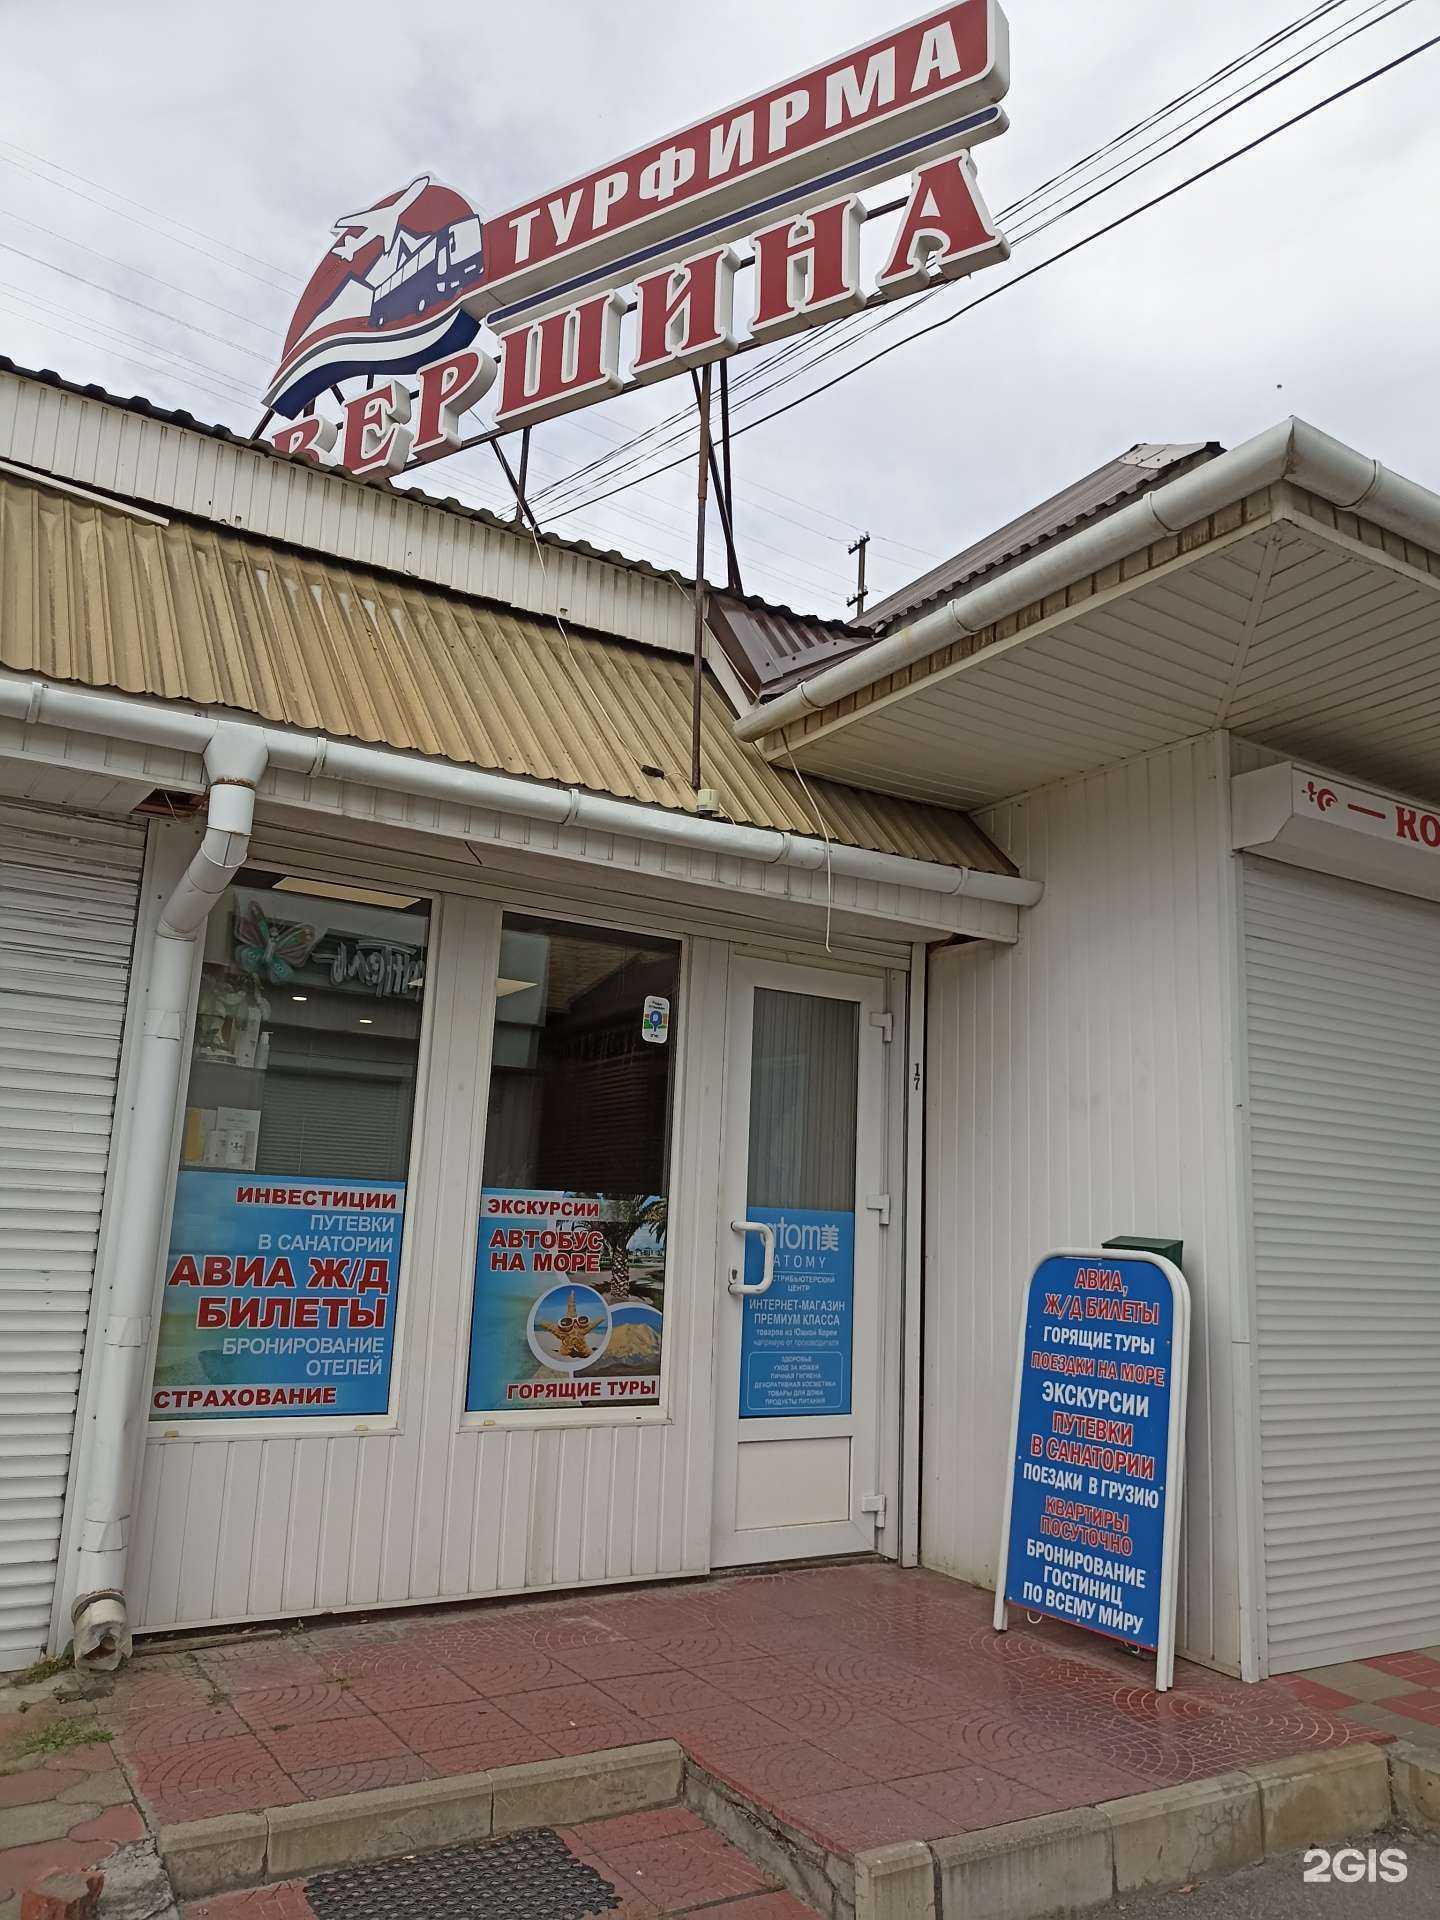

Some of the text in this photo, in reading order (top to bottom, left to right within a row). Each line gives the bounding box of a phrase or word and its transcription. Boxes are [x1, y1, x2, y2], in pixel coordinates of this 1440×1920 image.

[509, 22, 962, 264] ТУРФИРМА
[272, 150, 1003, 476] ВЕРШИНА
[236, 1187, 396, 1210] ИНВЕСТИЦИИ
[488, 1199, 600, 1217] ЭКСКУРСИИ
[310, 1215, 394, 1232] ПУТЕВКИ
[258, 1234, 392, 1252] В САНАТОРИИ
[489, 1229, 603, 1250] АВТОБУС
[168, 1255, 390, 1295] АВИА Ж/Д
[491, 1252, 601, 1272] НА МОРЕ
[774, 1254, 826, 1268] ATOMY
[1074, 1268, 1128, 1297] АВИА,
[196, 1296, 387, 1329] БИЛЕТЫ
[749, 1299, 845, 1311] ИНТЕРНЕТ-МАГАЗИН
[754, 1313, 840, 1326] ПРЕМИУМ КЛАССА
[1043, 1293, 1160, 1325] Ж/Д БИЛЕТЫ
[223, 1337, 384, 1355] БРОНИРОВАНИЕ
[1043, 1326, 1155, 1355] ГОРЯЩИЕ ТУРЫ
[306, 1355, 382, 1376] ОТЕЛЕЙ
[1031, 1351, 1165, 1387] ПОЕЗДКИ НА МОРЕ
[153, 1387, 337, 1409] СТРАХОВАНИЕ
[507, 1380, 656, 1400] ГОРЯЩИЕ ТУРЫ
[1042, 1380, 1149, 1418] ЭКСКУРСИИ
[1052, 1410, 1134, 1447] ПУТЕВКИ
[1031, 1434, 1155, 1480] В САНАТОРИИ
[1023, 1463, 1158, 1509] ПОЕЗДКИ В ГРУЗИЮ
[1044, 1495, 1129, 1533] КВАРТИРЫ
[1040, 1517, 1133, 1556] ПОСУТОЧНО
[1026, 1538, 1146, 1588] БРОНИРОВАНИЕ
[1044, 1566, 1122, 1608] ГОСТИНИЦ
[1023, 1581, 1144, 1634] ПО ВСЕМУ МИРУ
